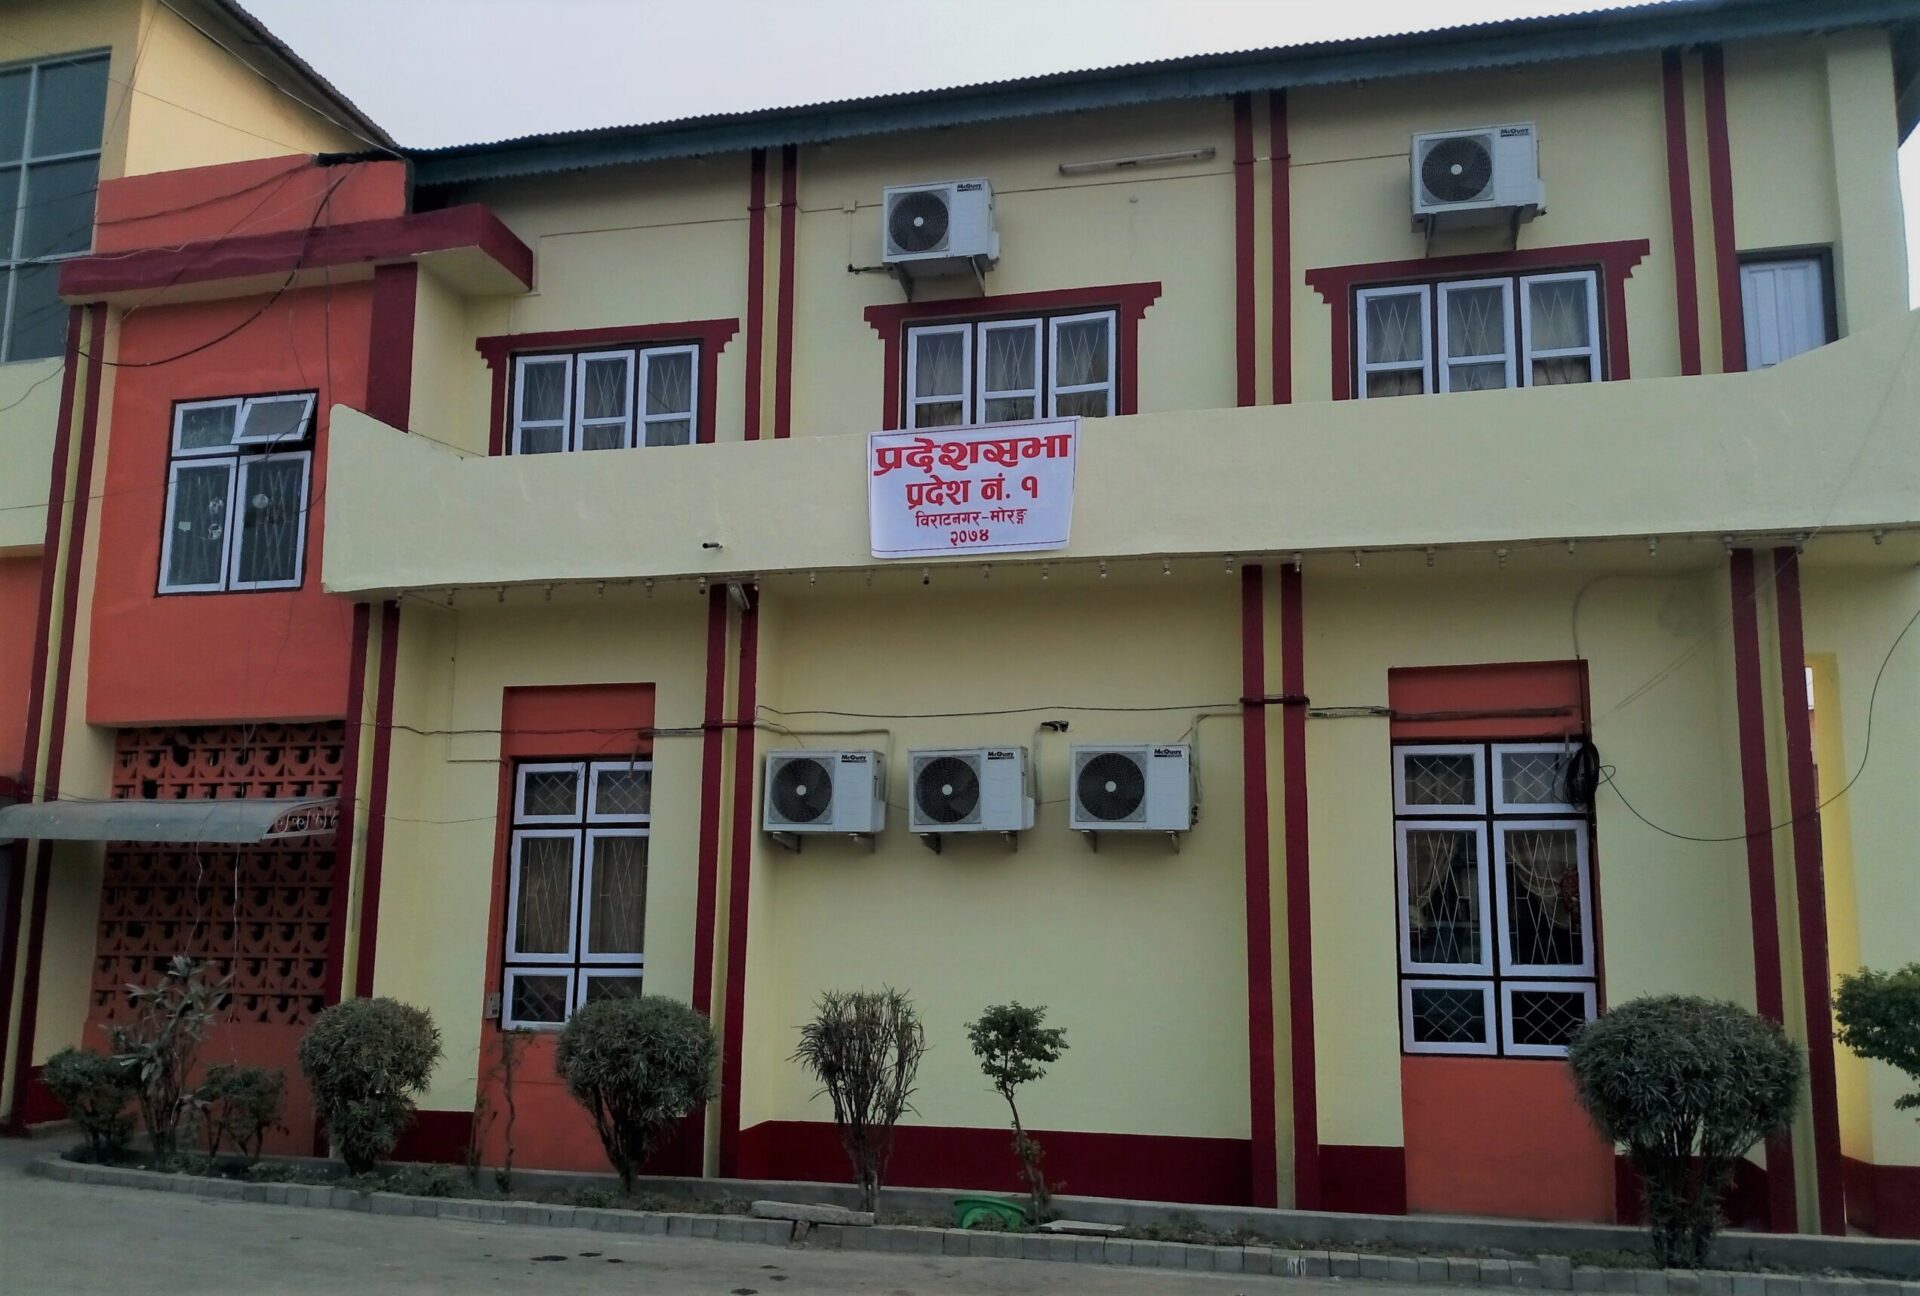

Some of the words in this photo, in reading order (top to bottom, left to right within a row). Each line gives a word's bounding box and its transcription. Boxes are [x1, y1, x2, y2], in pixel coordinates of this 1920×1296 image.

[873, 434, 1072, 476] प्रदेशसभा
[905, 475, 971, 510] प्रदेश
[981, 472, 1011, 501] नं.
[1021, 475, 1038, 499] १
[950, 528, 989, 546] २०७४
